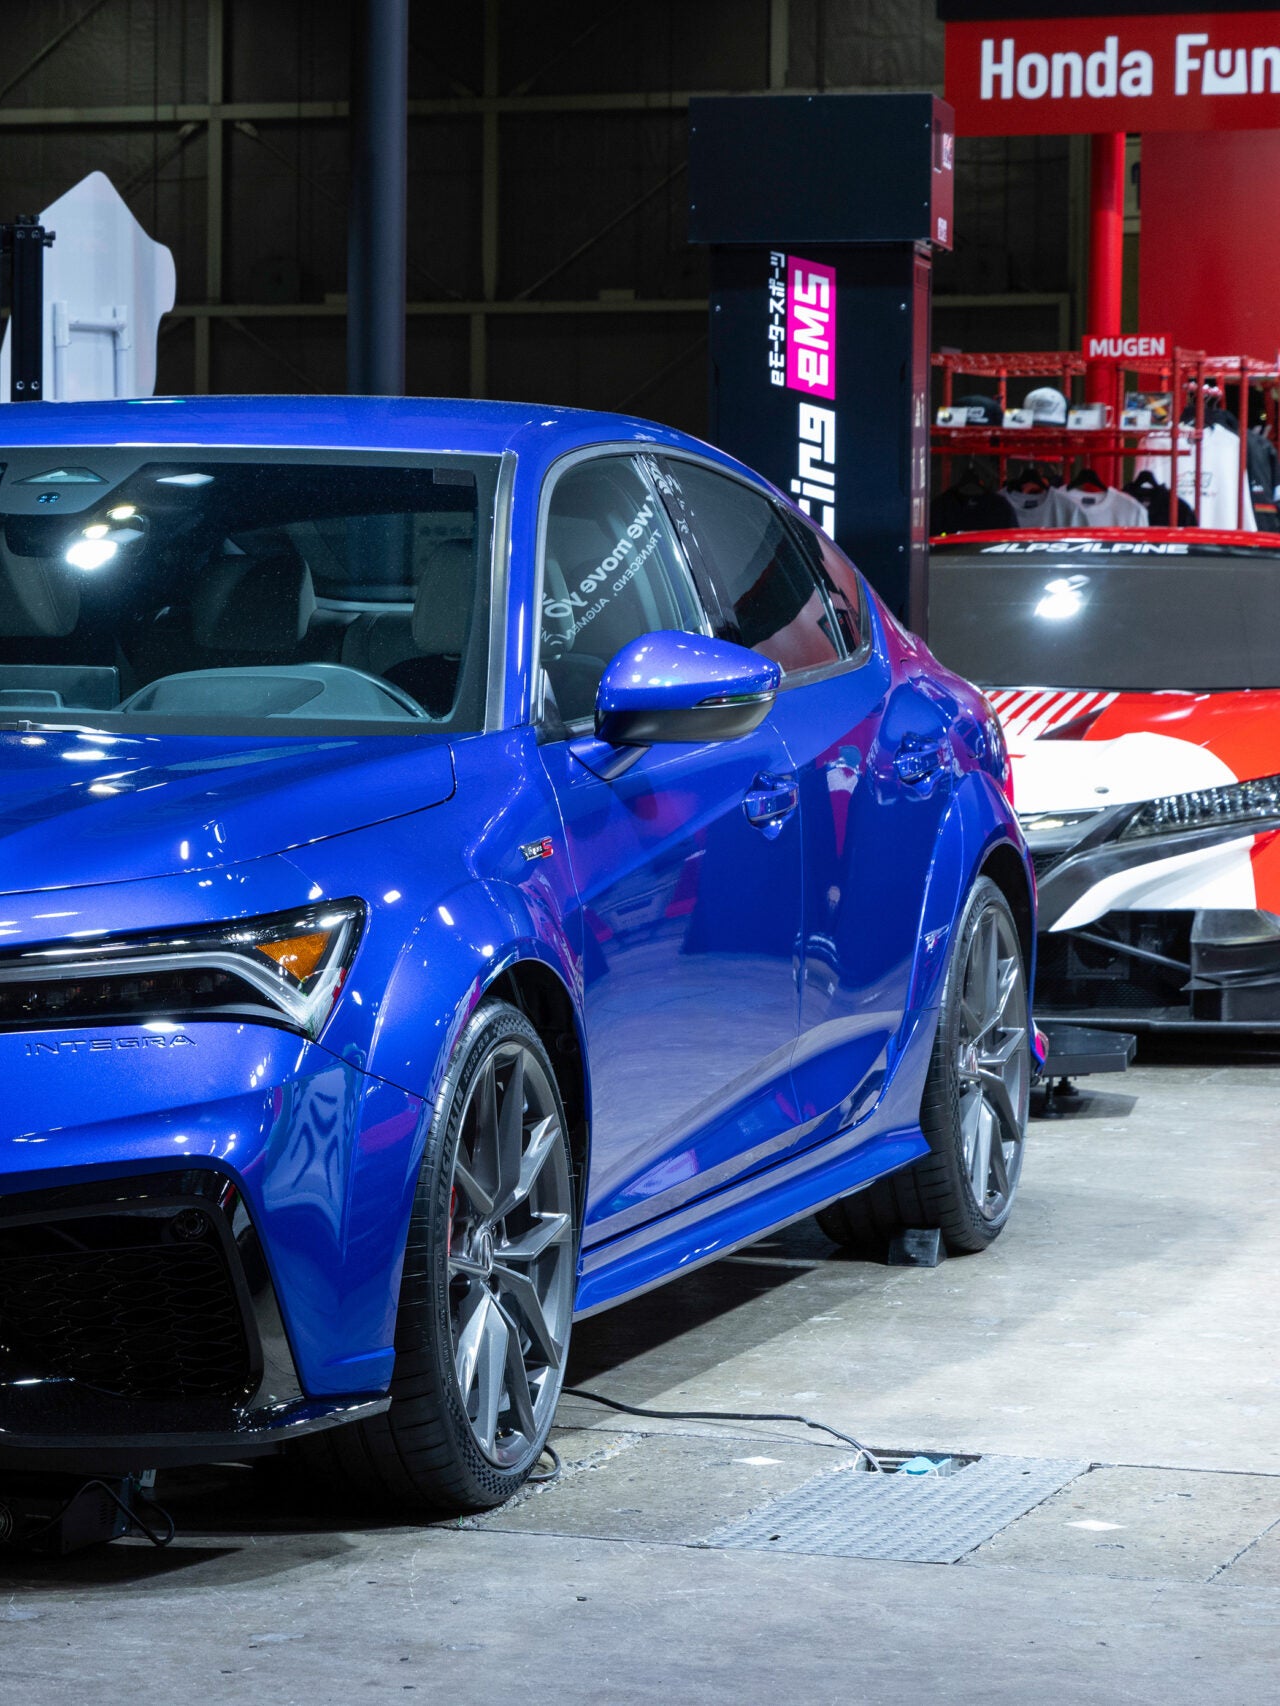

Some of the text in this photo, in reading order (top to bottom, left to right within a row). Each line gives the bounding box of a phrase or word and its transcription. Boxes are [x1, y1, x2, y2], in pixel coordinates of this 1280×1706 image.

[979, 32, 1280, 100] Honda Fun
[793, 269, 830, 388] eMS
[1089, 337, 1166, 357] MUGEN
[24, 1034, 198, 1057] INTEGRA
[439, 1085, 465, 1210] MICHELIN
